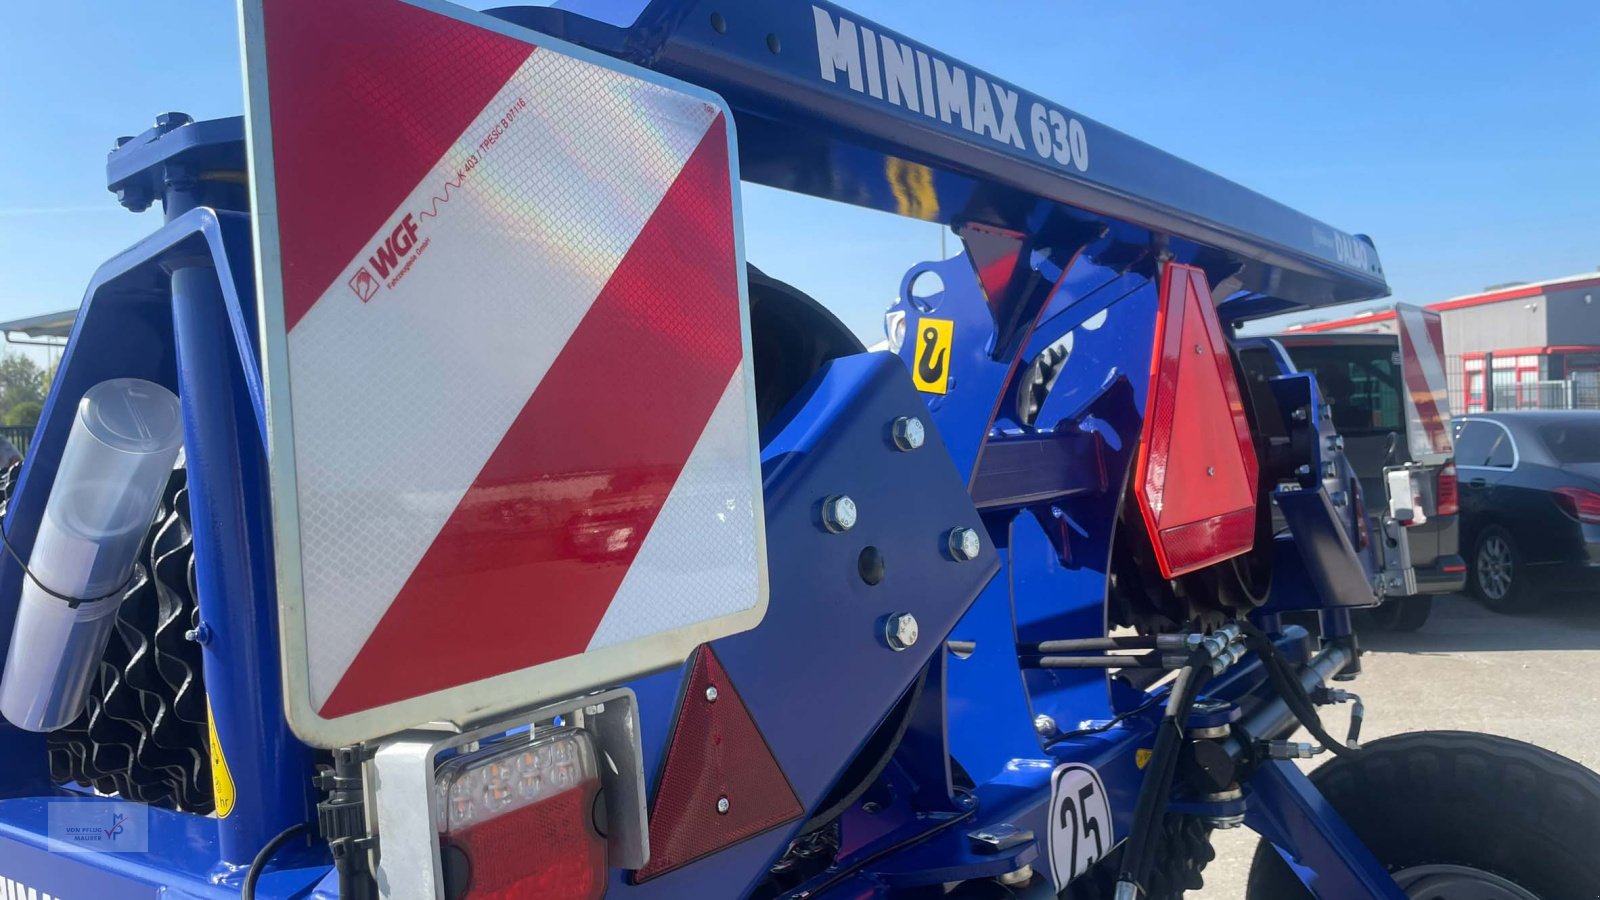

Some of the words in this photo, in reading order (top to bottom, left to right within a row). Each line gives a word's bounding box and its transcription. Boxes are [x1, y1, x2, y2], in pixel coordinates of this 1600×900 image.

[812, 5, 1026, 151] MINIMAX
[1030, 102, 1088, 172] 630
[456, 167, 467, 182] K
[464, 154, 479, 173] 403
[479, 124, 504, 153] TPESC
[500, 118, 510, 129] B
[368, 212, 418, 280] WGF
[415, 236, 431, 255] GmbH
[1060, 782, 1103, 880] 25
